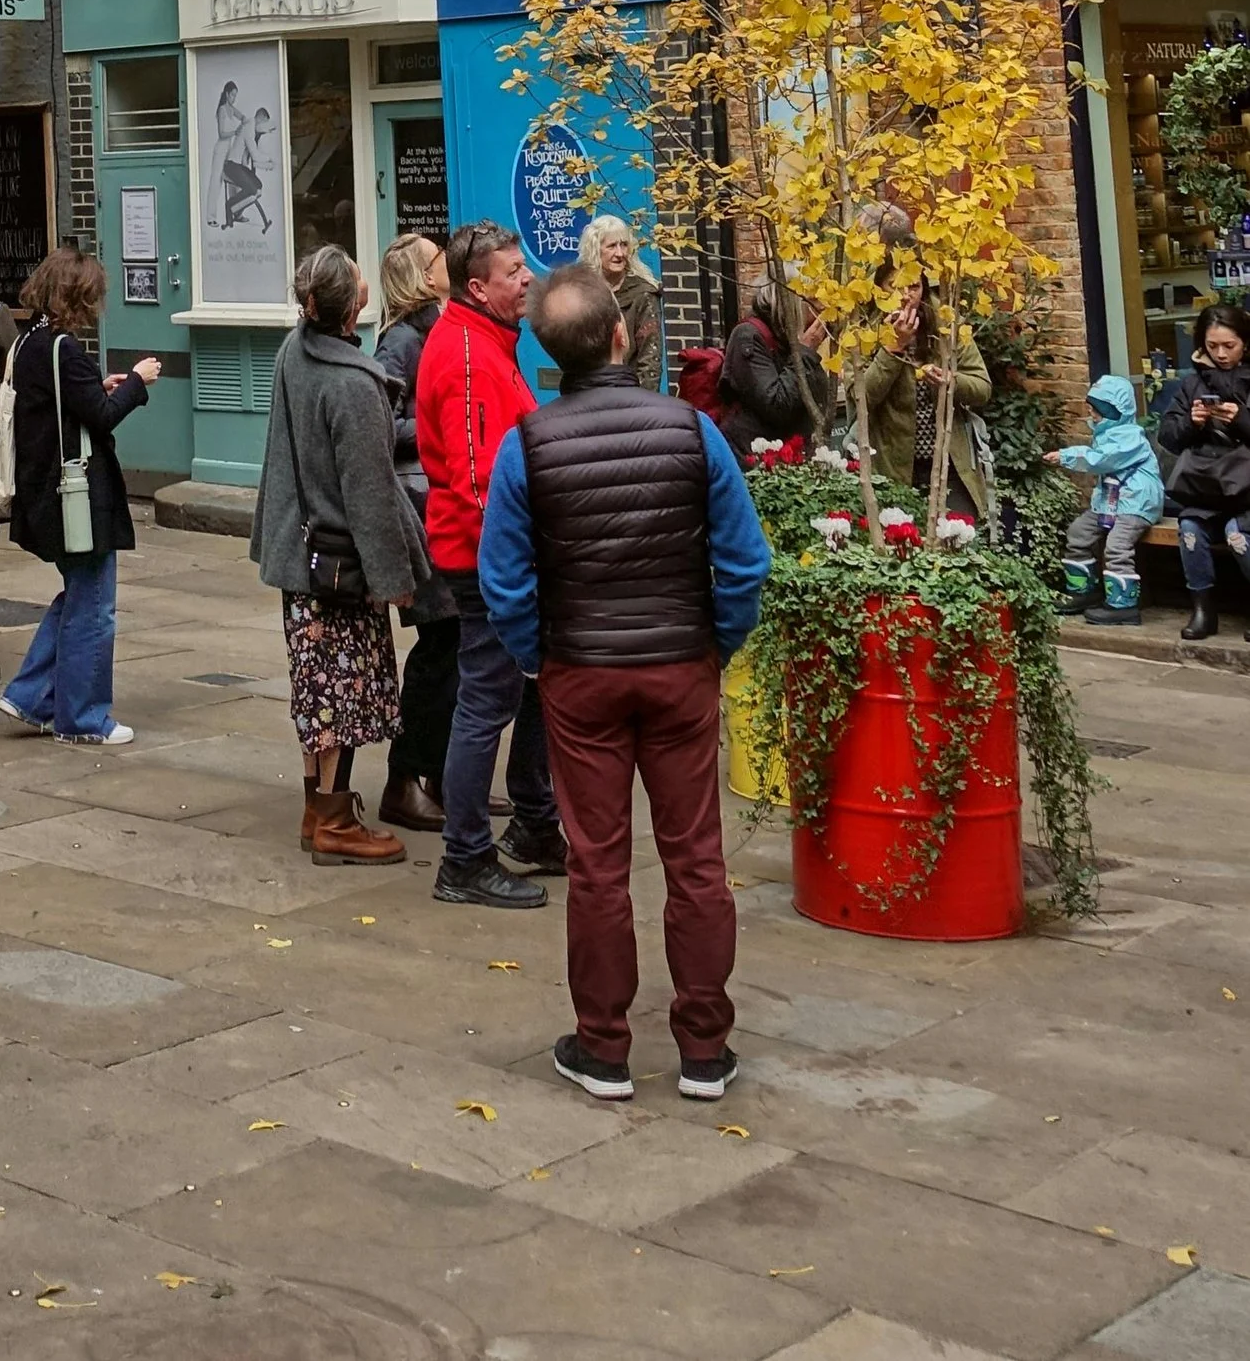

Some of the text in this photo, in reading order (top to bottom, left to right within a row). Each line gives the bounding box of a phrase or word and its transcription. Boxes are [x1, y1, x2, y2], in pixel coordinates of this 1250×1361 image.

[1146, 42, 1199, 59] NATURAL
[406, 148, 414, 156] At
[415, 147, 426, 156] the
[431, 156, 443, 166] you
[423, 165, 438, 174] walk
[414, 175, 426, 184] rub
[428, 176, 442, 185] your
[525, 175, 554, 189] PLEASE
[569, 174, 584, 187] AS
[531, 188, 572, 208] QUIET
[403, 204, 413, 212] No
[414, 203, 431, 212] need
[433, 203, 440, 212] to
[530, 208, 541, 220] AS
[397, 216, 407, 225] No
[408, 216, 425, 225] need
[427, 216, 434, 224] to
[411, 226, 439, 234] clothes
[532, 230, 579, 255] PEACE
